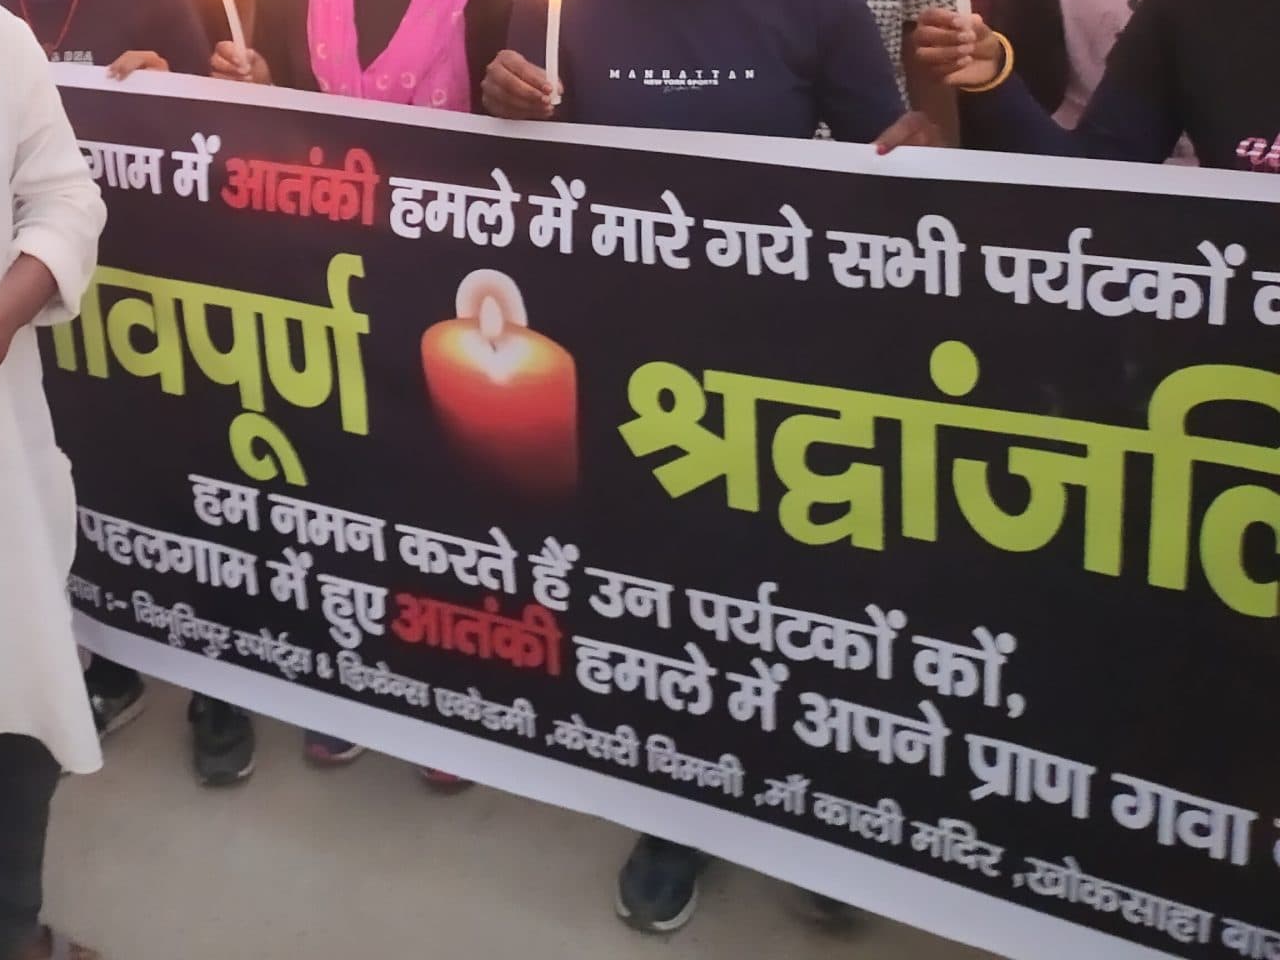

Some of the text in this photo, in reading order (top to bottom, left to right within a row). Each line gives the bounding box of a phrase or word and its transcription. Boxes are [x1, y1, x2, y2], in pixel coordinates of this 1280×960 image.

[609, 69, 755, 80] MANHATTAN
[77, 139, 164, 194] गाम
[171, 132, 220, 202] में
[221, 147, 379, 227] आतंकी
[388, 168, 521, 248] हमले
[528, 175, 587, 254] में
[590, 189, 694, 270] मारे
[703, 204, 813, 282] गये
[826, 214, 966, 298] सभी
[981, 227, 1248, 326] पर्यटकों
[52, 252, 370, 488] ावपूर्ण
[77, 505, 260, 596] पहलगाम
[265, 547, 314, 611] में
[317, 573, 389, 650] हुए
[391, 592, 564, 677] आतंकी
[571, 635, 716, 717] हमले
[726, 658, 791, 732] में
[793, 689, 951, 778] अपने
[965, 732, 1097, 820] प्राण
[1110, 773, 1259, 868] गवा
[188, 474, 1026, 719] हम नमन करते हैं उन पर्यटकों कों,
[812, 791, 905, 846] काली
